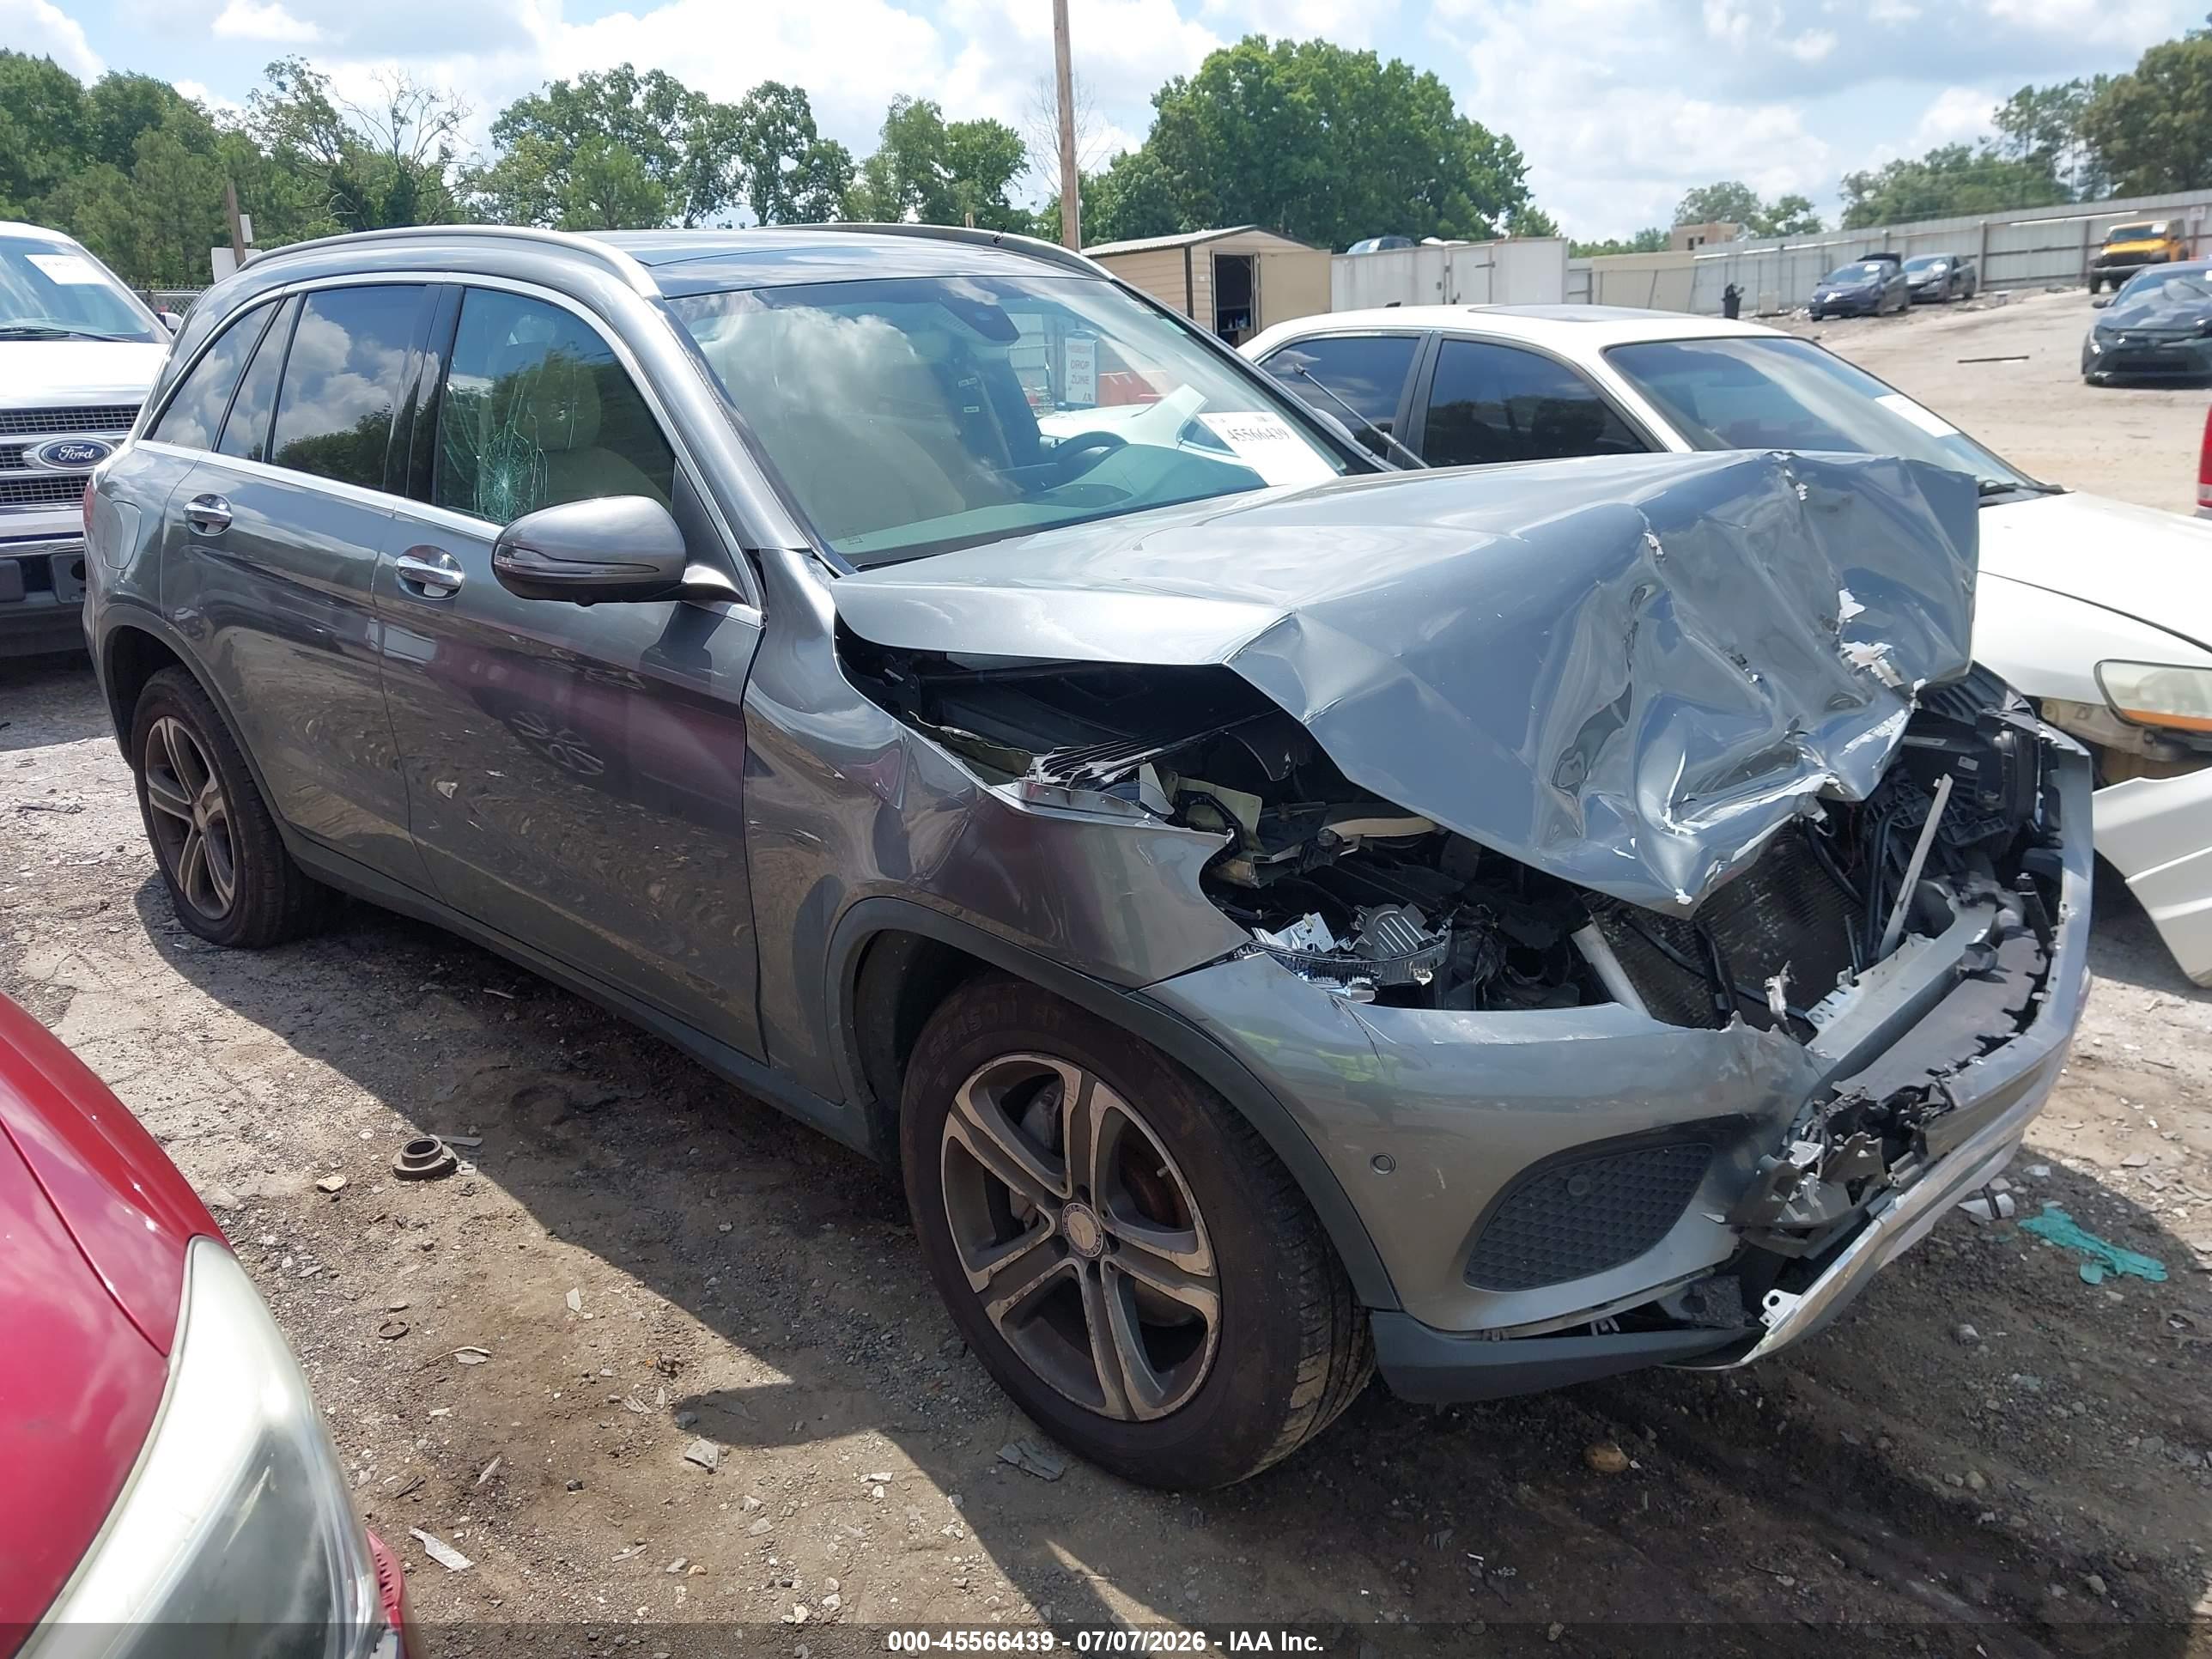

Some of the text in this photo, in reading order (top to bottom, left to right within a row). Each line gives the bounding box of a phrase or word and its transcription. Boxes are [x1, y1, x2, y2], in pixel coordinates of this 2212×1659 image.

[1070, 359, 1091, 371] DROP
[1226, 428, 1291, 441] 45566439
[58, 445, 95, 461] Ford
